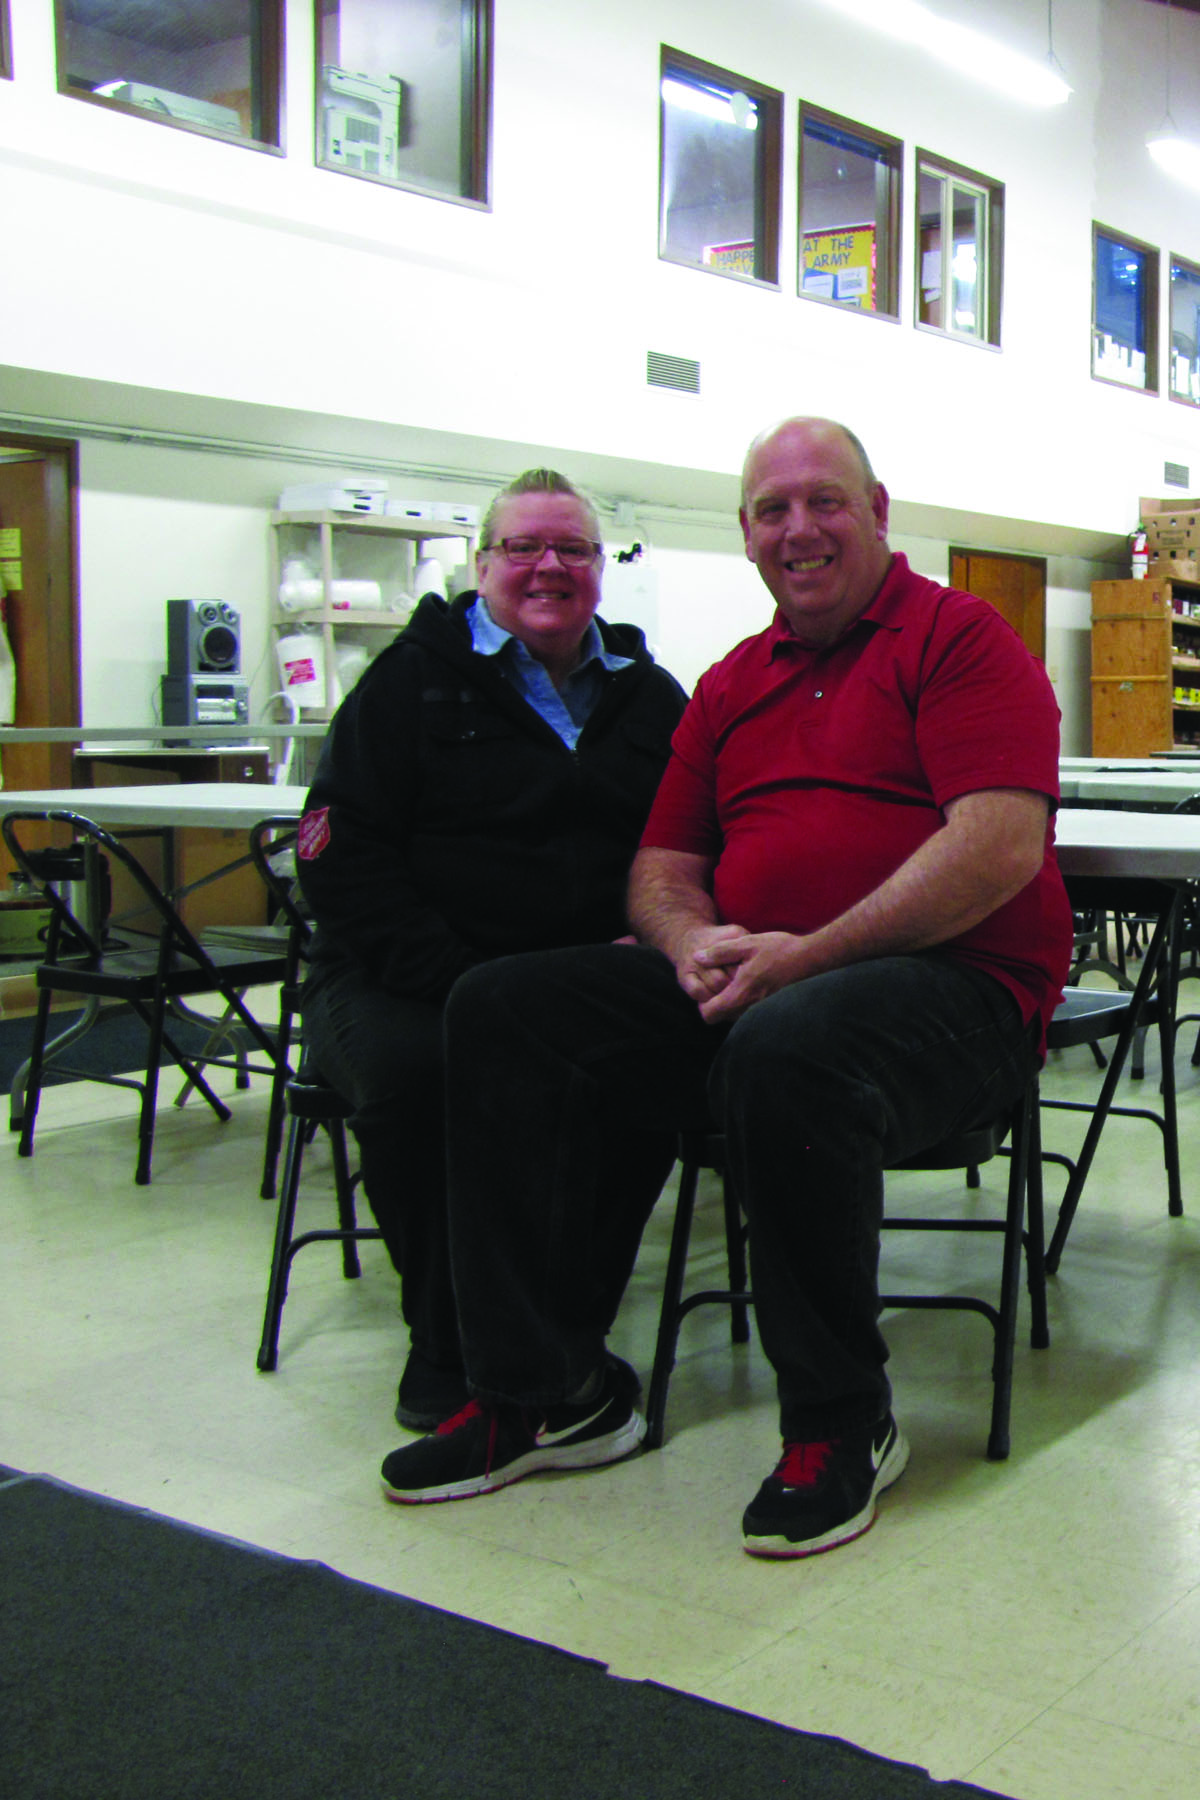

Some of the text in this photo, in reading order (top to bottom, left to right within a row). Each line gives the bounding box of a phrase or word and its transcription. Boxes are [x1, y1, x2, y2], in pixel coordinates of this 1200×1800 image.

[803, 239, 819, 253] AT
[831, 235, 854, 251] THE
[813, 252, 851, 268] ARMY
